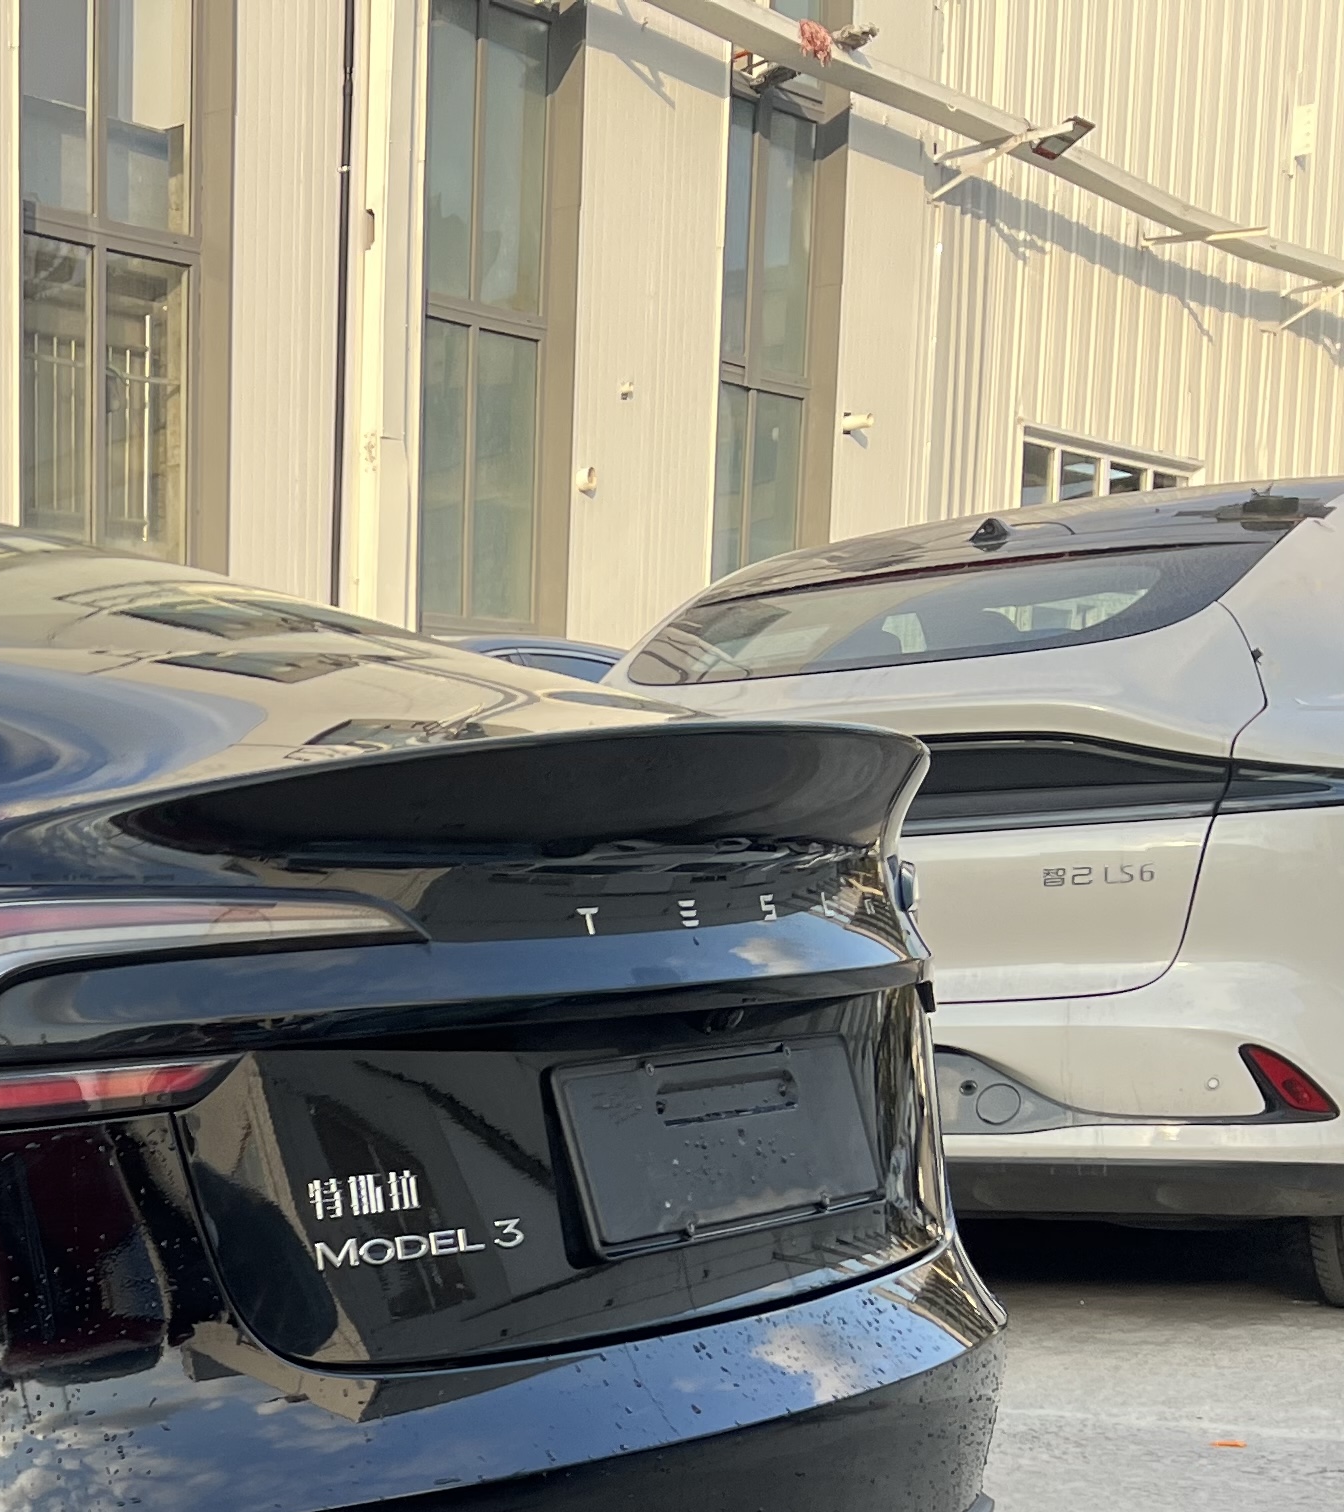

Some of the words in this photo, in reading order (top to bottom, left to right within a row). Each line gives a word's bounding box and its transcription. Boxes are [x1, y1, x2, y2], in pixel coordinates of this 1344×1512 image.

[1104, 863, 1155, 885] LS6
[314, 1228, 486, 1271] MODEL
[493, 1218, 525, 1248] 3
